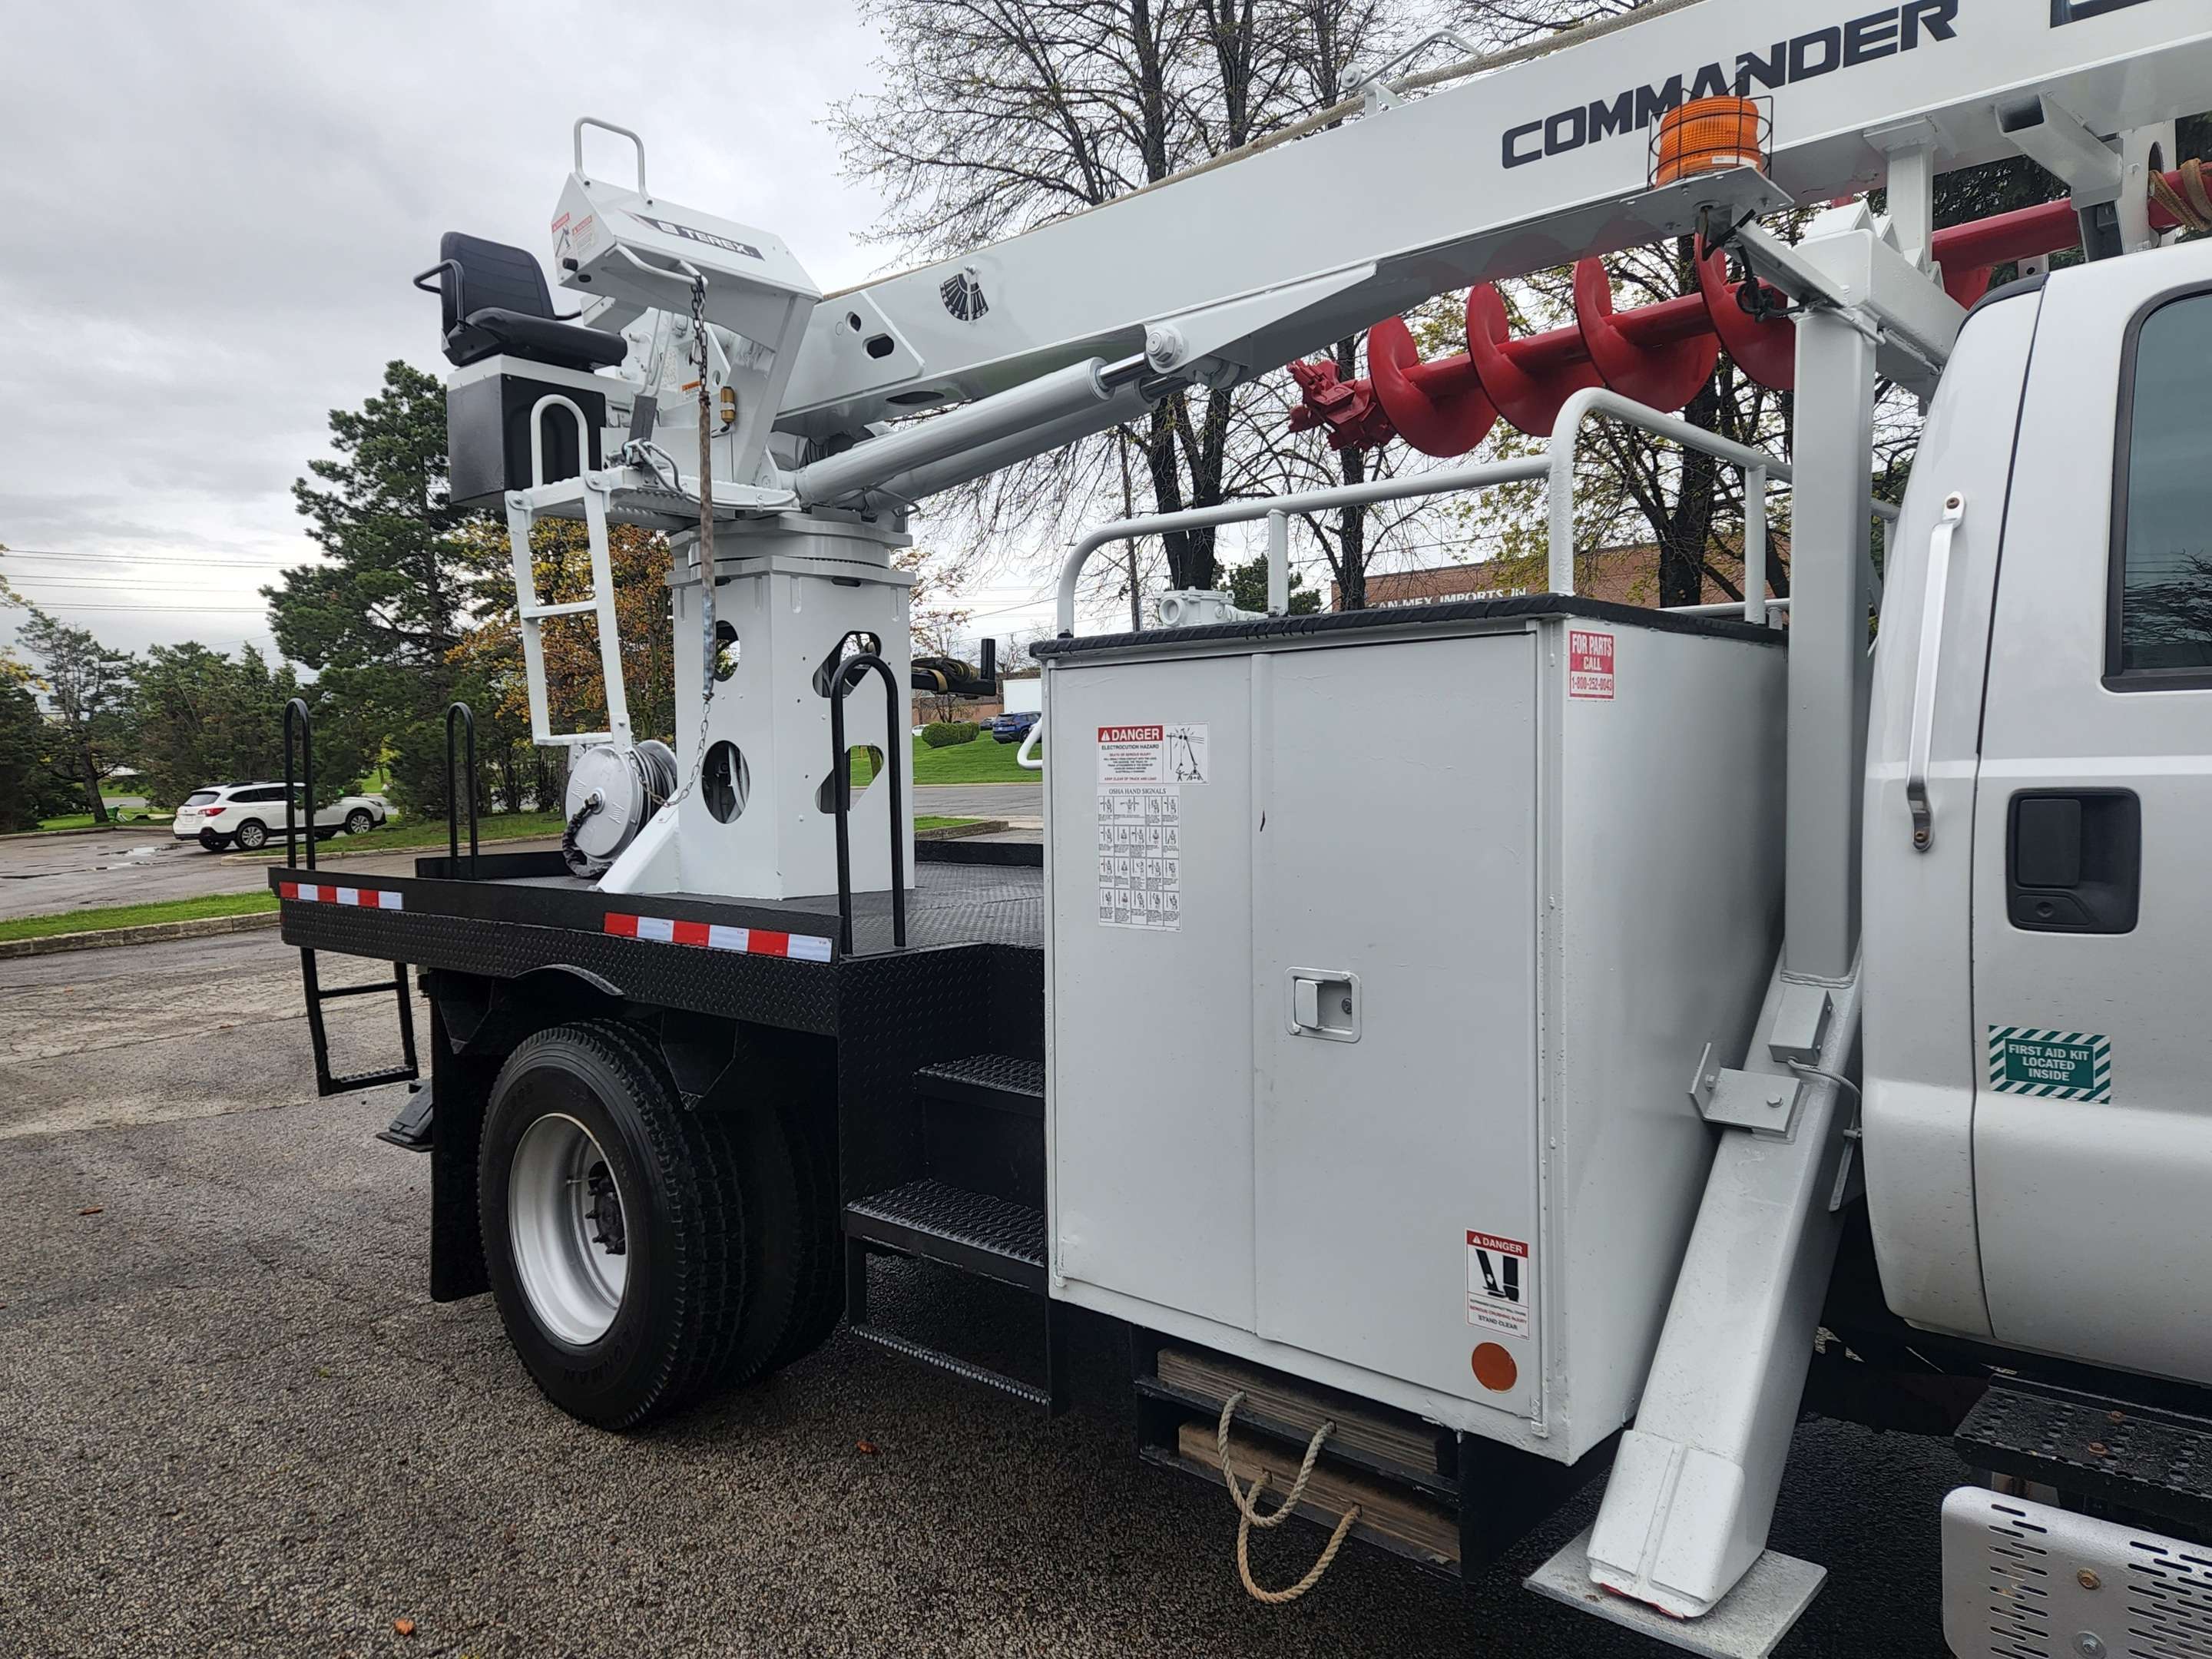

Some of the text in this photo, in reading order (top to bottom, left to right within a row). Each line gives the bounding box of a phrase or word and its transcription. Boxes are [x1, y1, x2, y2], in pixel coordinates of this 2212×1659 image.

[1502, 0, 1958, 169] COMMANDER
[680, 227, 750, 256] TEREX
[1439, 589, 1504, 603] IMPORTS
[1571, 633, 1612, 657] FOR PARTS
[1583, 656, 1602, 671] CALL
[1111, 728, 1161, 741] DANGER
[2008, 1044, 2090, 1061] FIRST AID KIT
[2022, 1056, 2075, 1071] LOCATED
[2028, 1068, 2070, 1081] INSIDE
[1482, 1237, 1523, 1254] DANGER
[1478, 1314, 1518, 1330] STAND CLEAR
